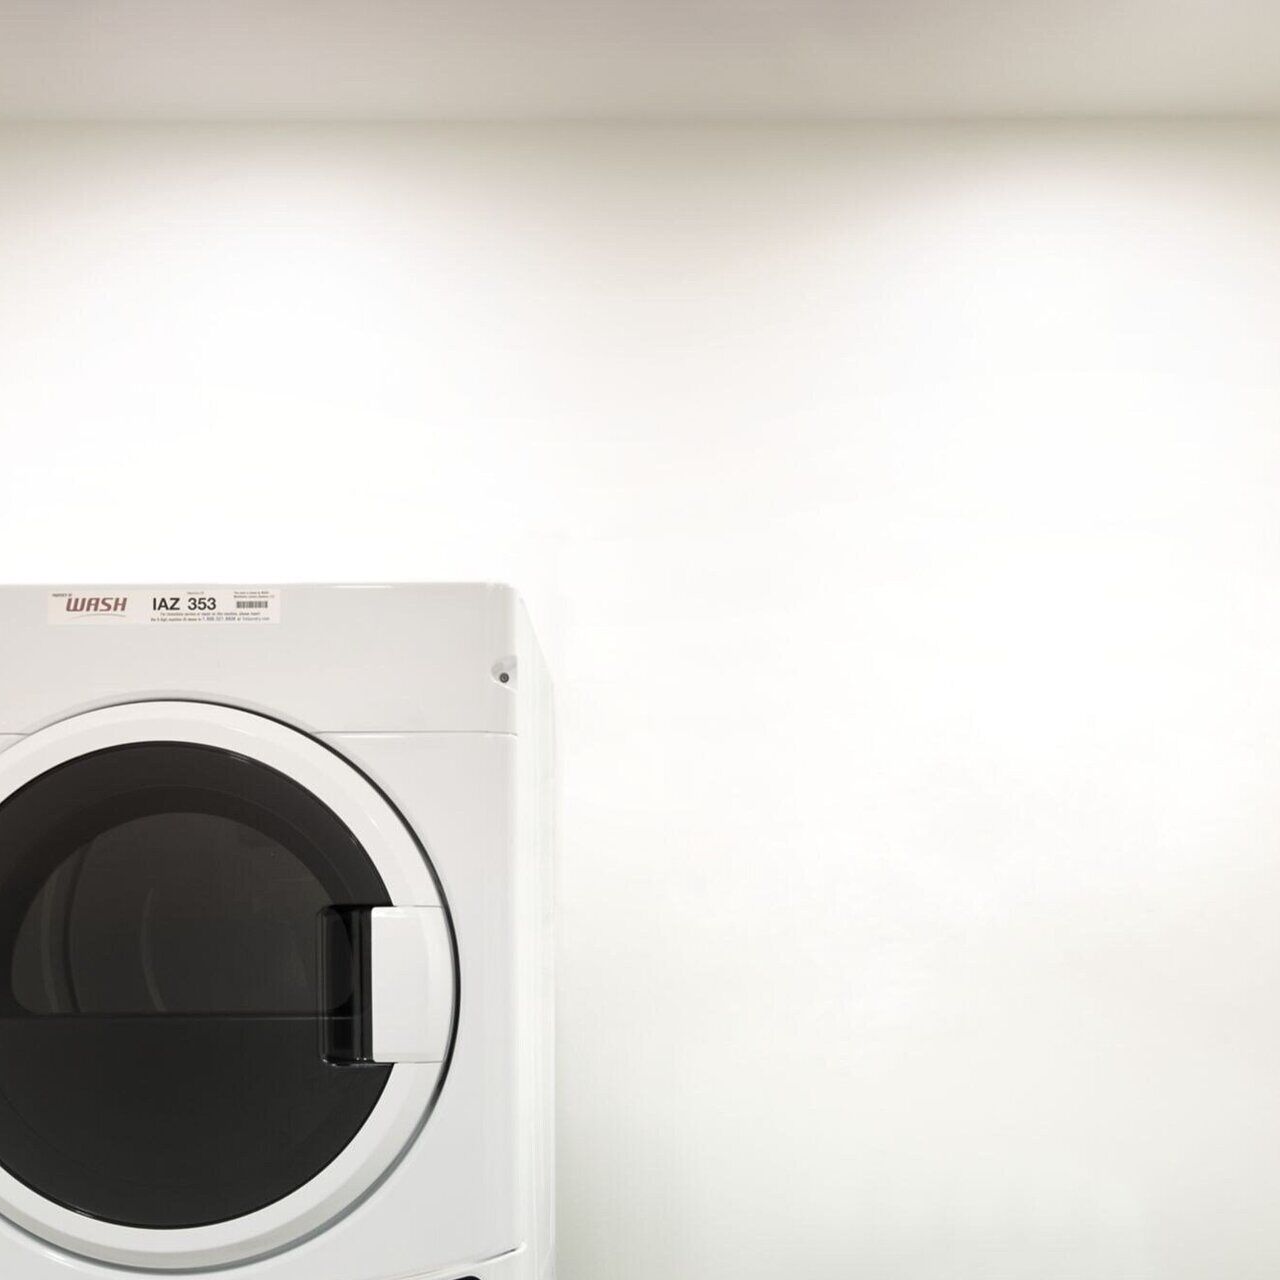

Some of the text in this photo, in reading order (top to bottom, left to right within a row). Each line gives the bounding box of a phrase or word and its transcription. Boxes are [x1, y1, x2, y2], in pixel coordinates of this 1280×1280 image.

[65, 597, 128, 612] WASH
[152, 597, 217, 610] IAZ 353
